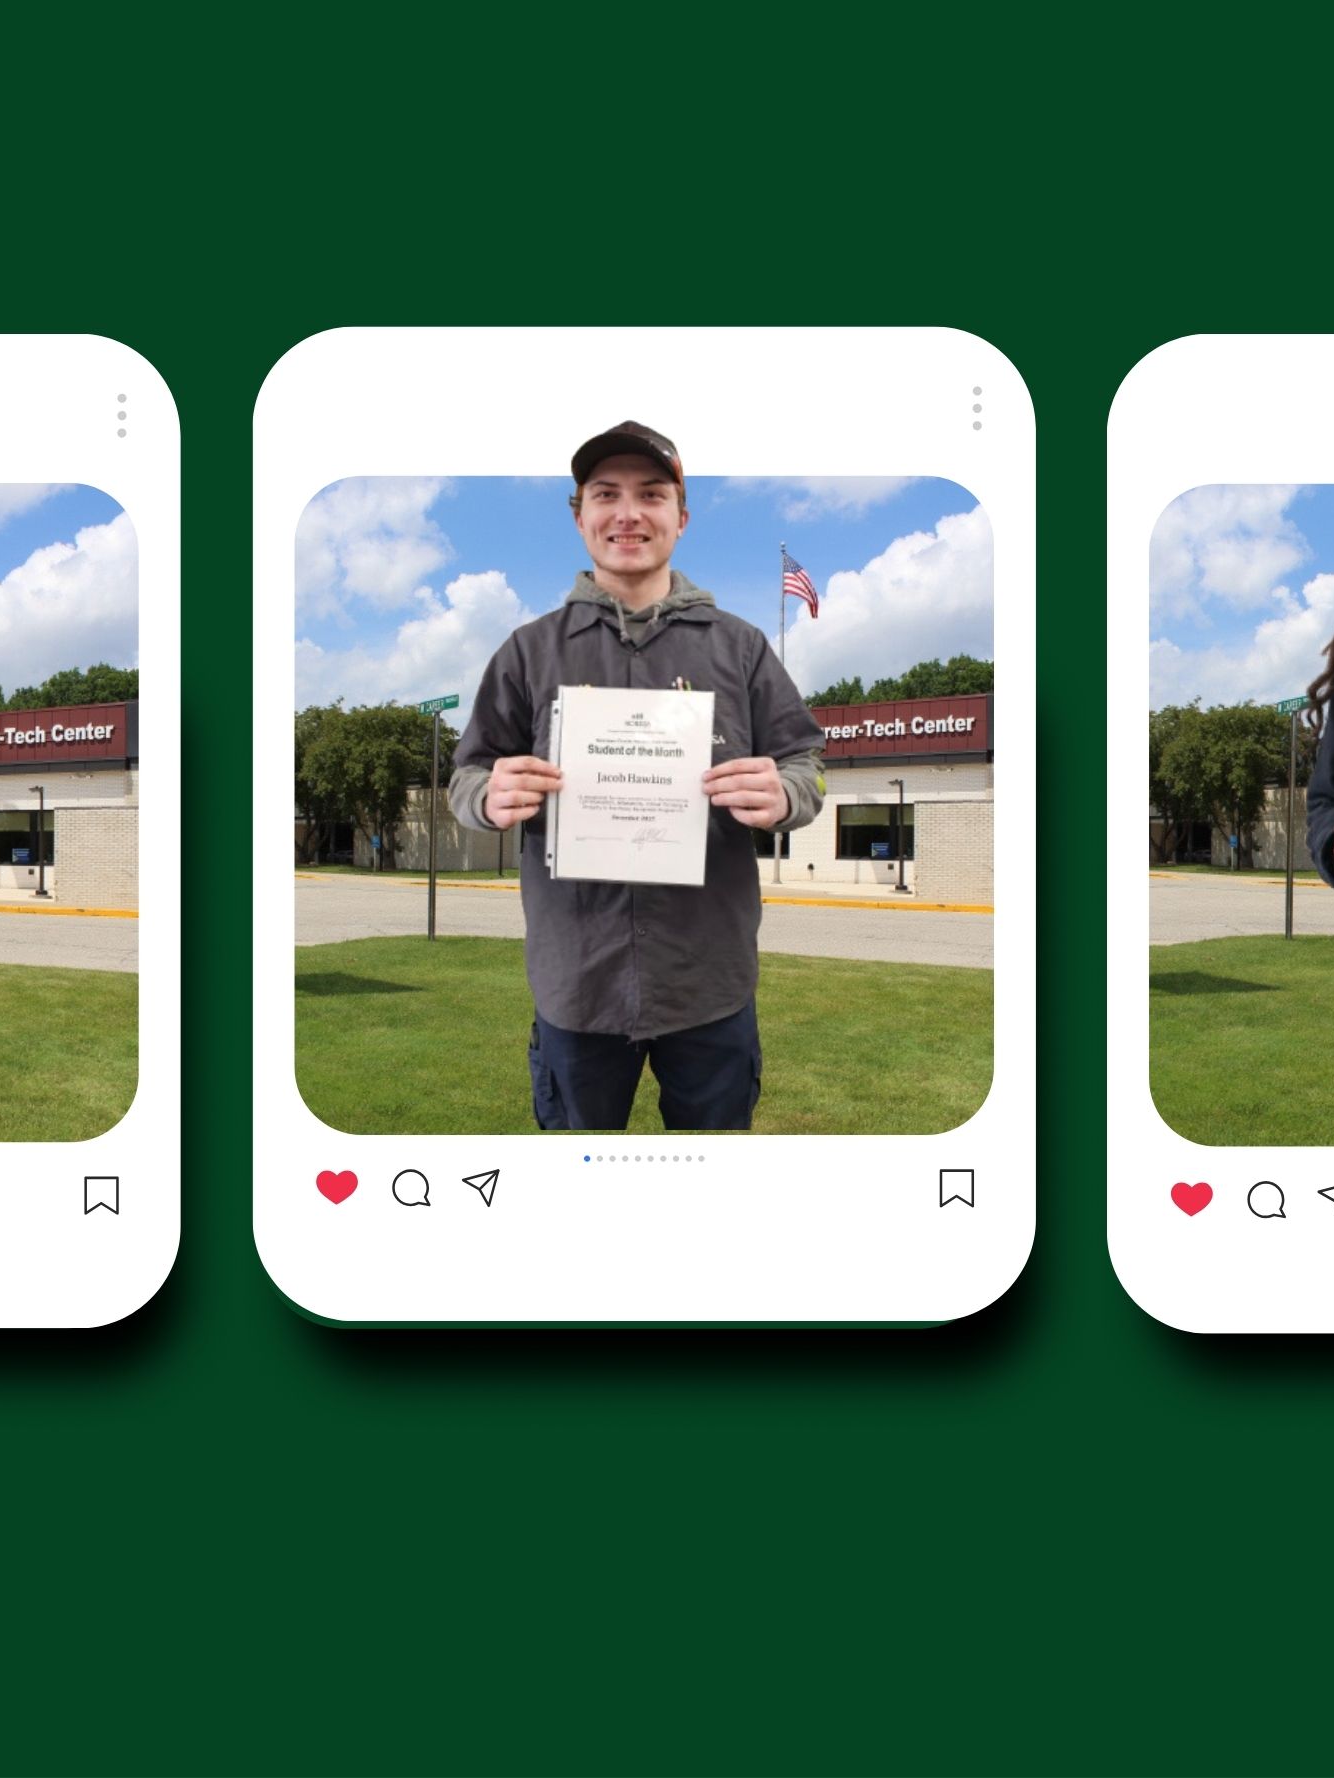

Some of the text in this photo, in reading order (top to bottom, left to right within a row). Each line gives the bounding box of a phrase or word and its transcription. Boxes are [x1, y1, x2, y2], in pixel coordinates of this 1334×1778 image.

[911, 714, 975, 733] Center
[51, 722, 114, 742] Center
[588, 744, 685, 758] Student of the Month
[597, 772, 672, 785] Jacob Hawkins
